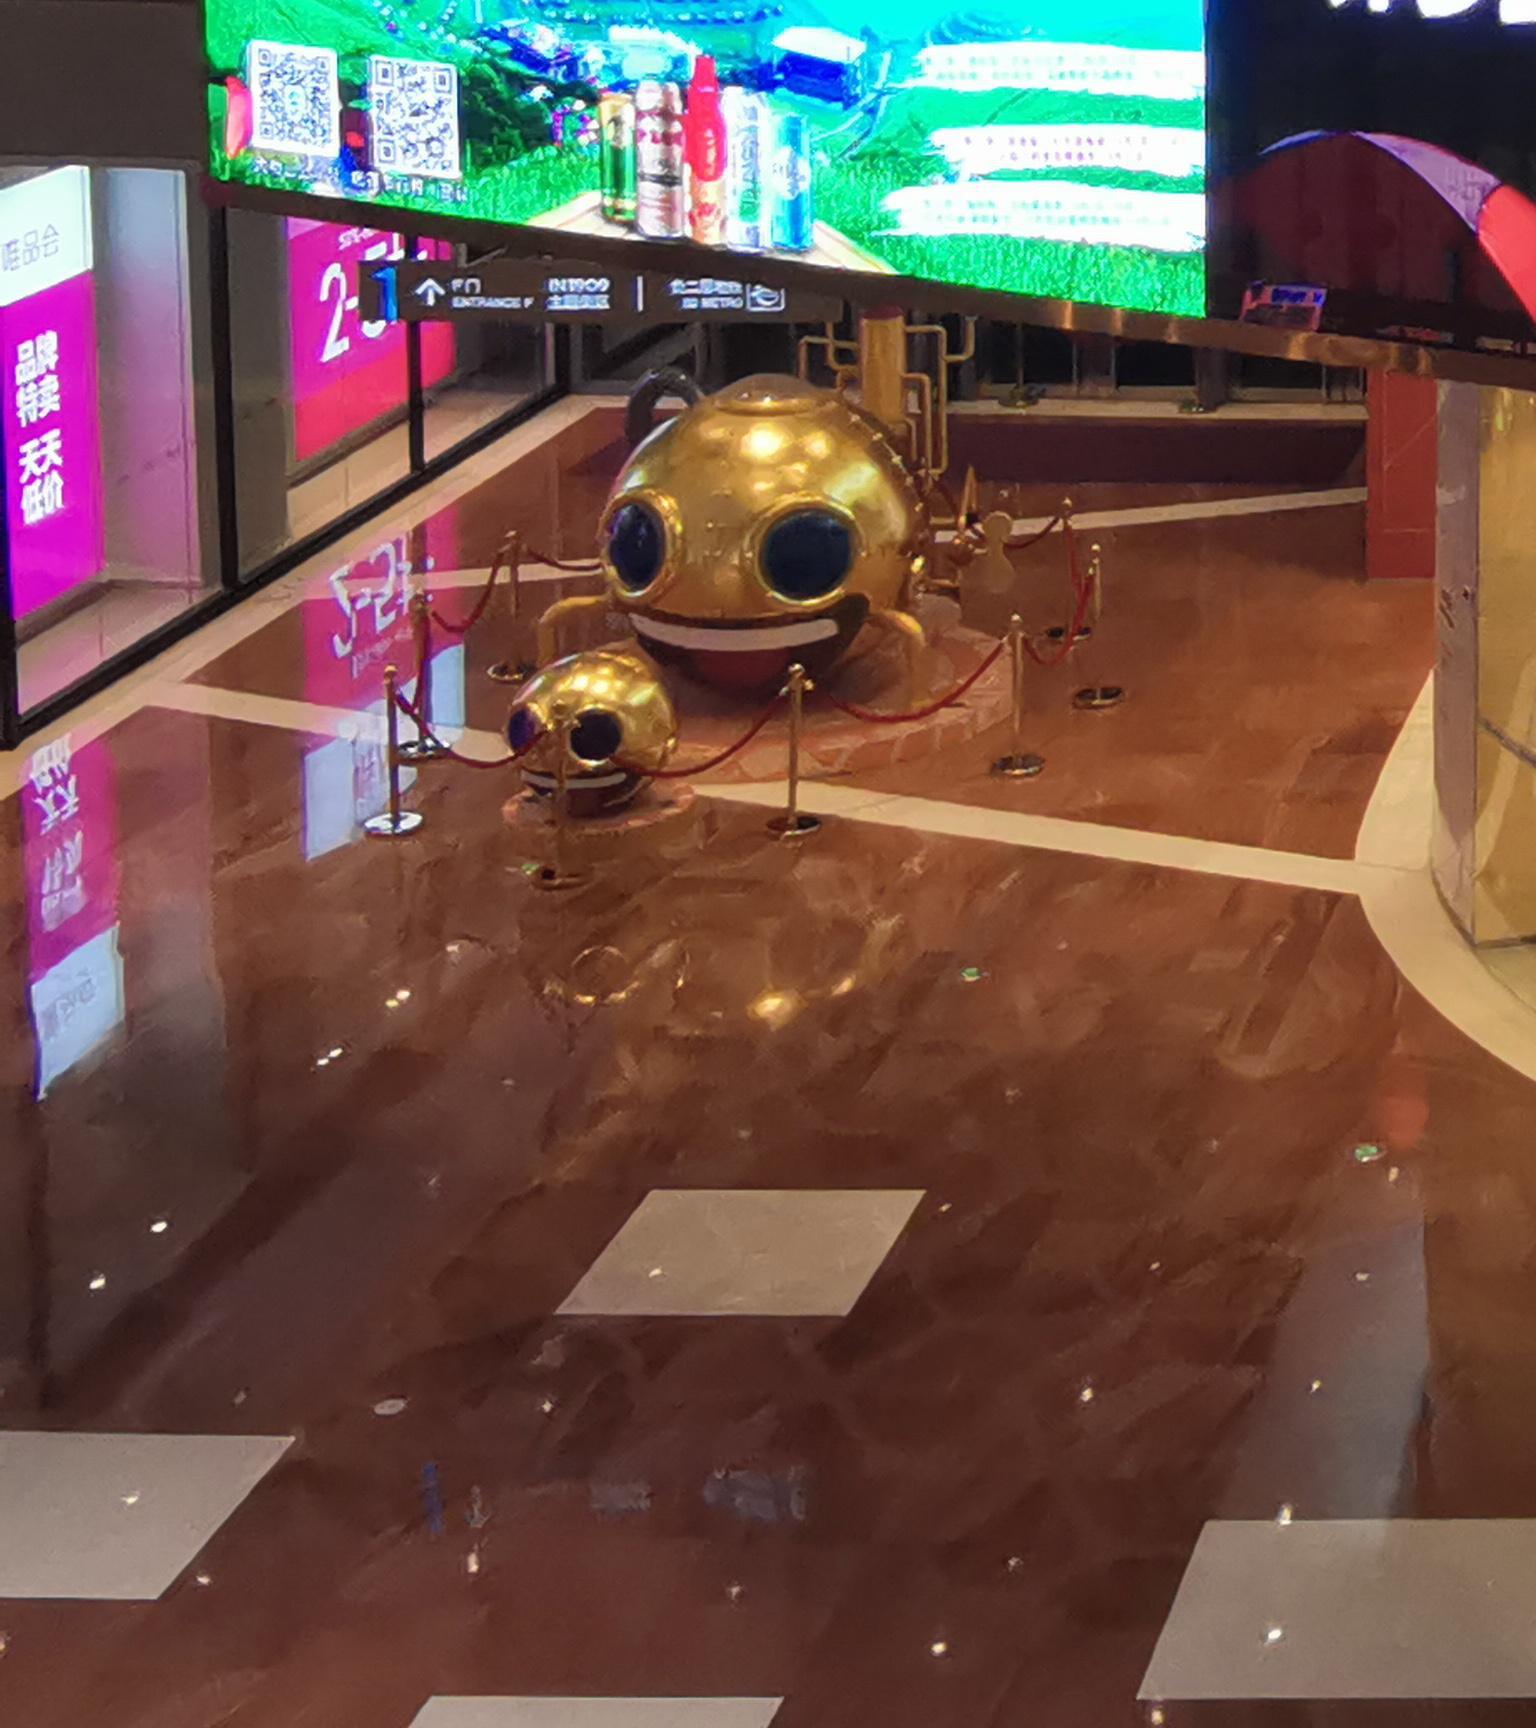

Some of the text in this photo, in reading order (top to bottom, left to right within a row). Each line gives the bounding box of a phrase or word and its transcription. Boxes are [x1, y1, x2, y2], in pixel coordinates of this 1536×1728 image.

[371, 266, 398, 324] 1
[15, 330, 59, 385] 品牌
[16, 374, 61, 428] 特卖
[19, 428, 63, 484] 天天
[21, 470, 64, 525] 低价
